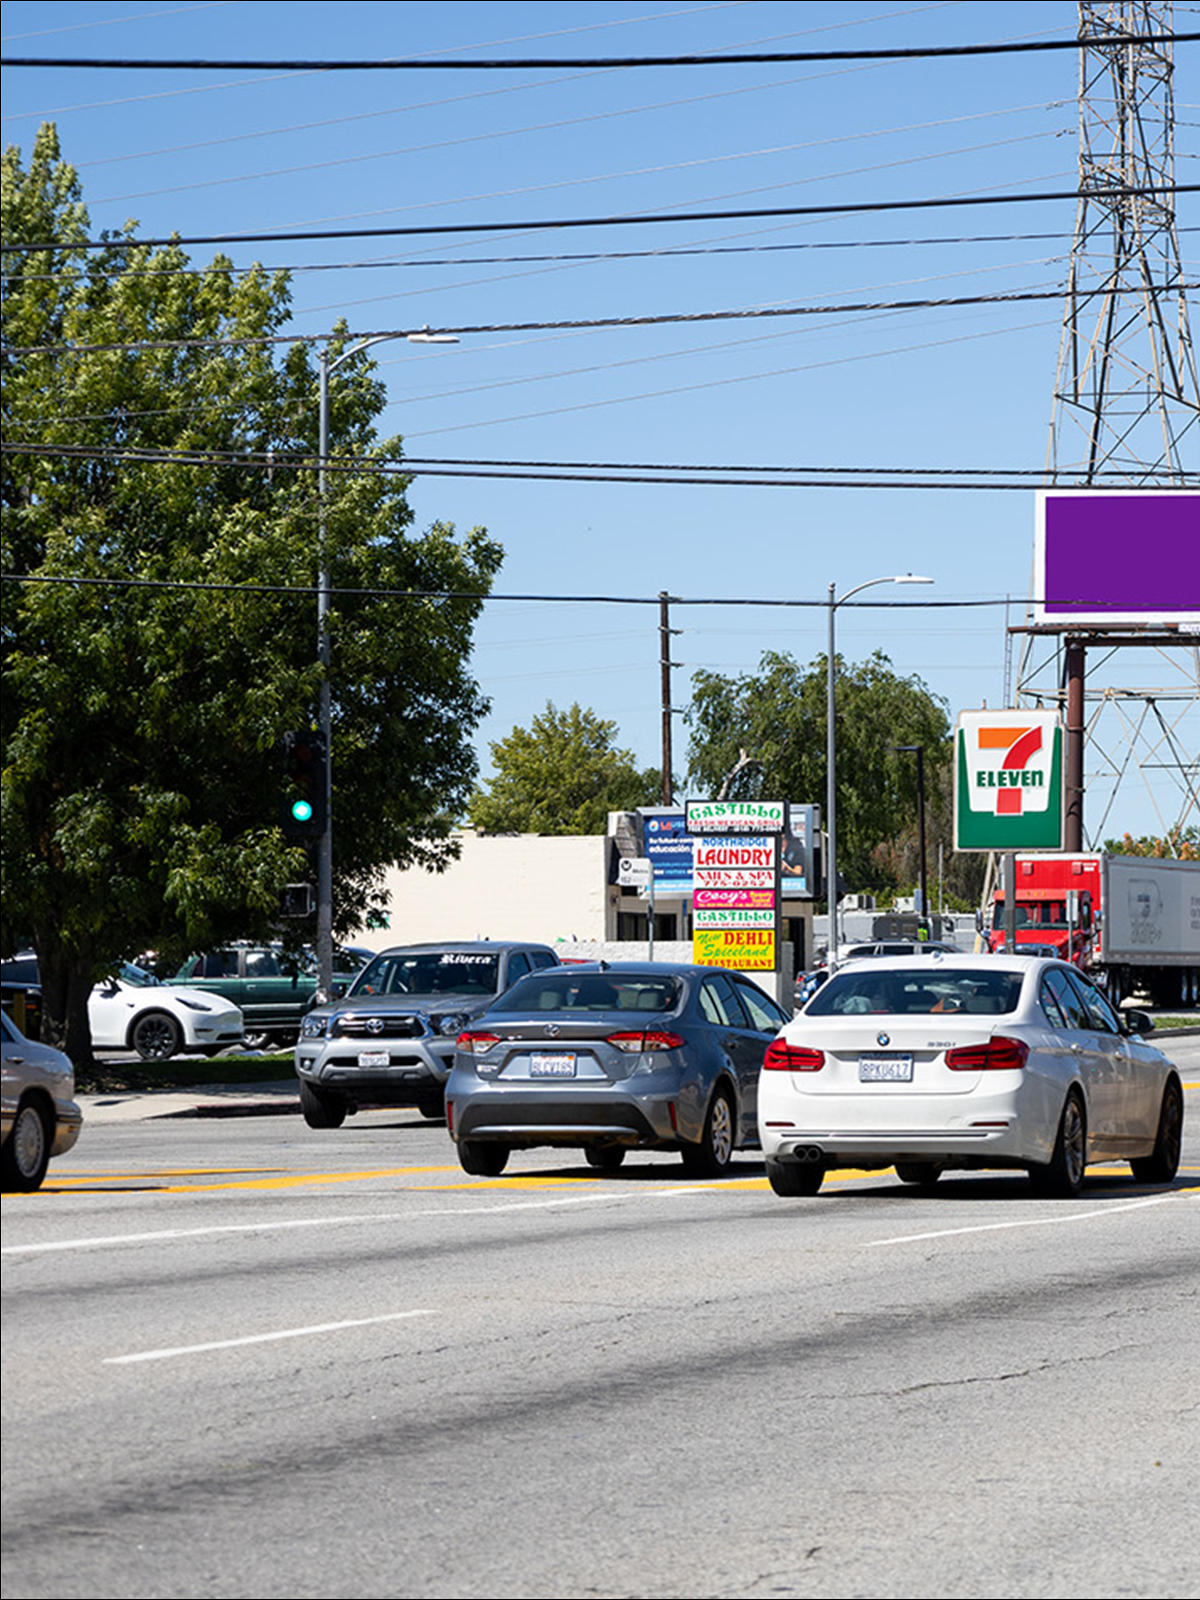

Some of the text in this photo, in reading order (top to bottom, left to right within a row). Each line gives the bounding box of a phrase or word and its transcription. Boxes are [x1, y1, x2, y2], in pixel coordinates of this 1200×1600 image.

[978, 726, 1042, 814] 7
[702, 837, 768, 847] NORTHRIDGE
[697, 849, 773, 866] LAUNDRY
[697, 872, 732, 880] NAILS
[749, 872, 773, 880] SPA
[724, 932, 773, 945] DEHLI
[702, 943, 770, 960] Spiceland
[439, 954, 491, 965] Rivera
[707, 959, 773, 968] RESTAURANT
